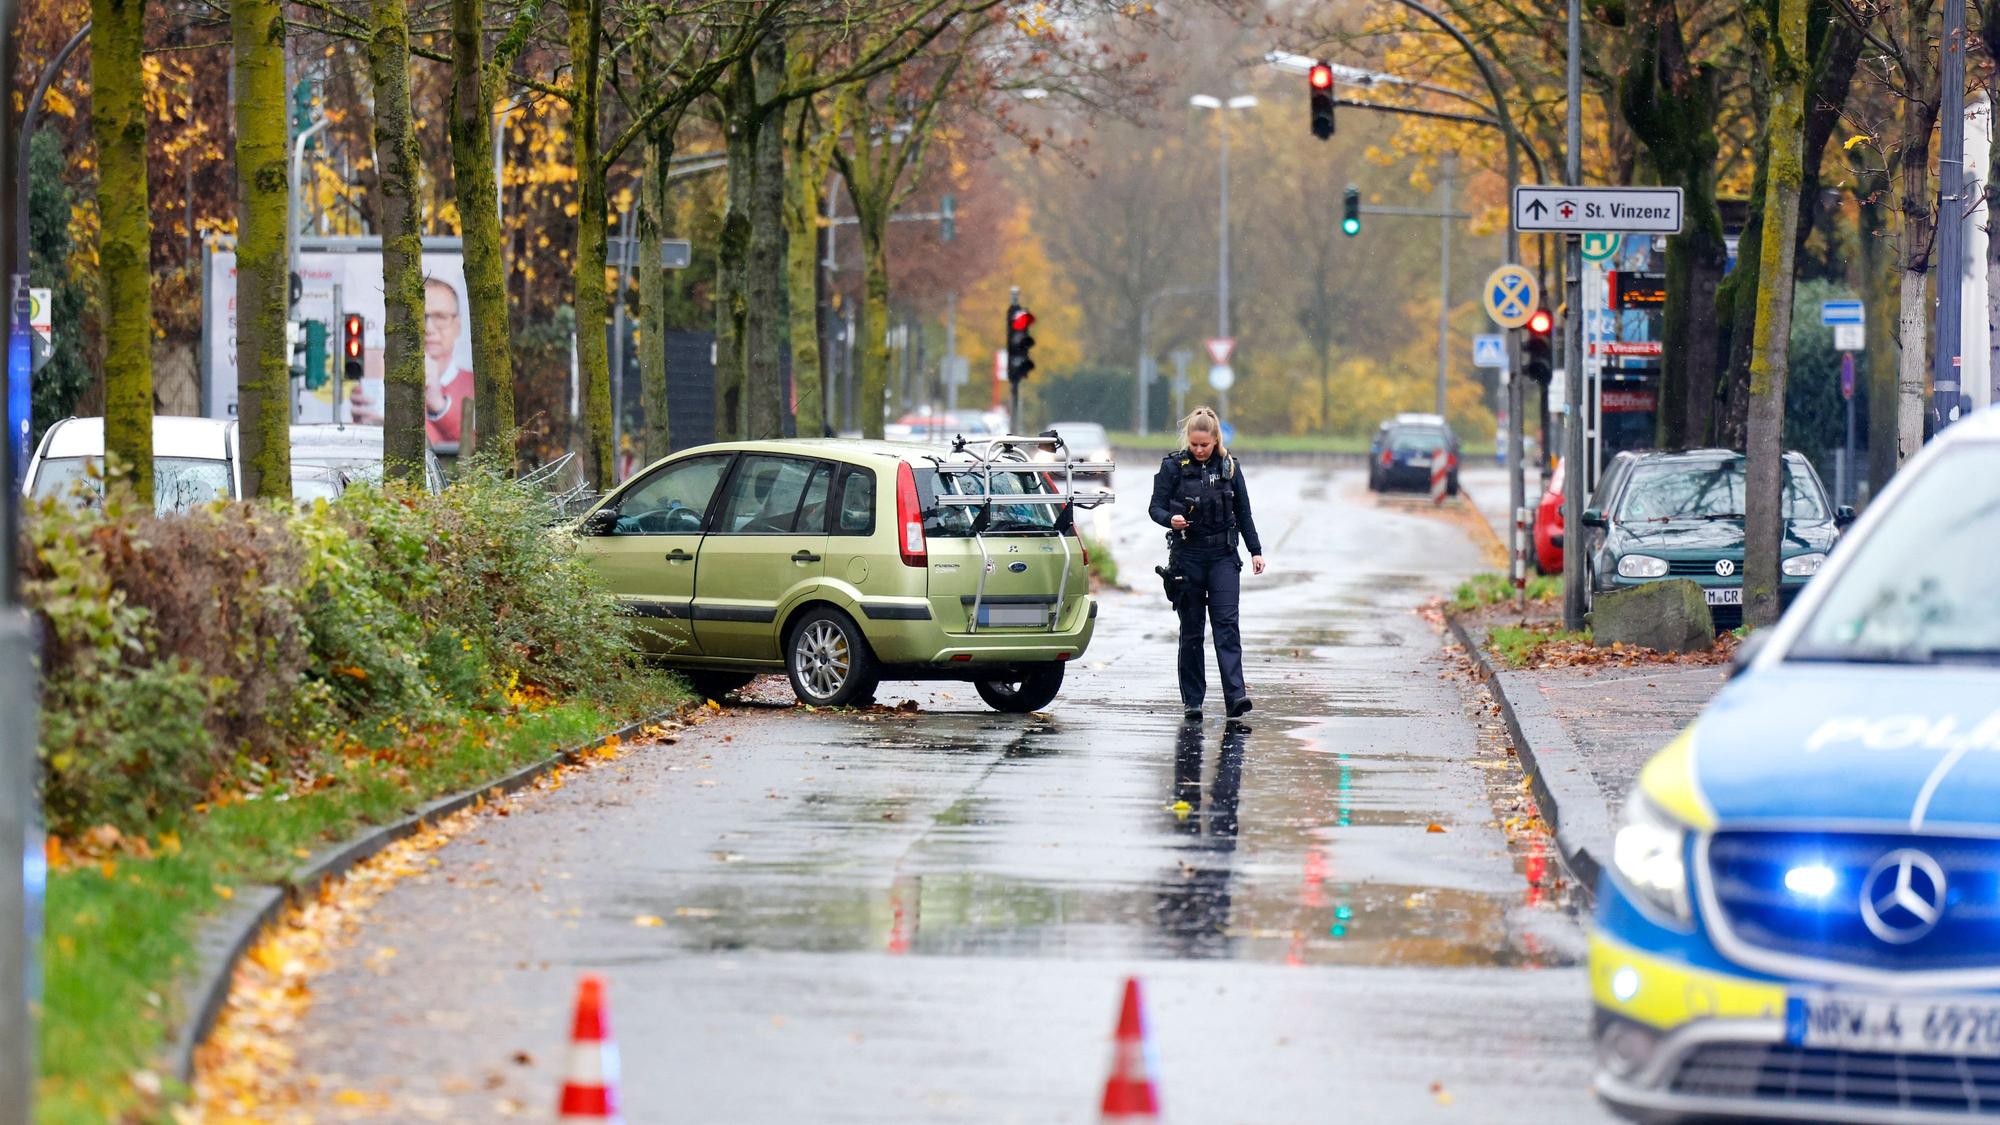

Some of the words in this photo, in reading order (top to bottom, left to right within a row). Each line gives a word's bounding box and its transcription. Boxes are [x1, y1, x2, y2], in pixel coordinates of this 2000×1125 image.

[1585, 202, 1604, 218] St.
[1610, 202, 1671, 219] Vinzenz
[1724, 590, 1738, 603] CR
